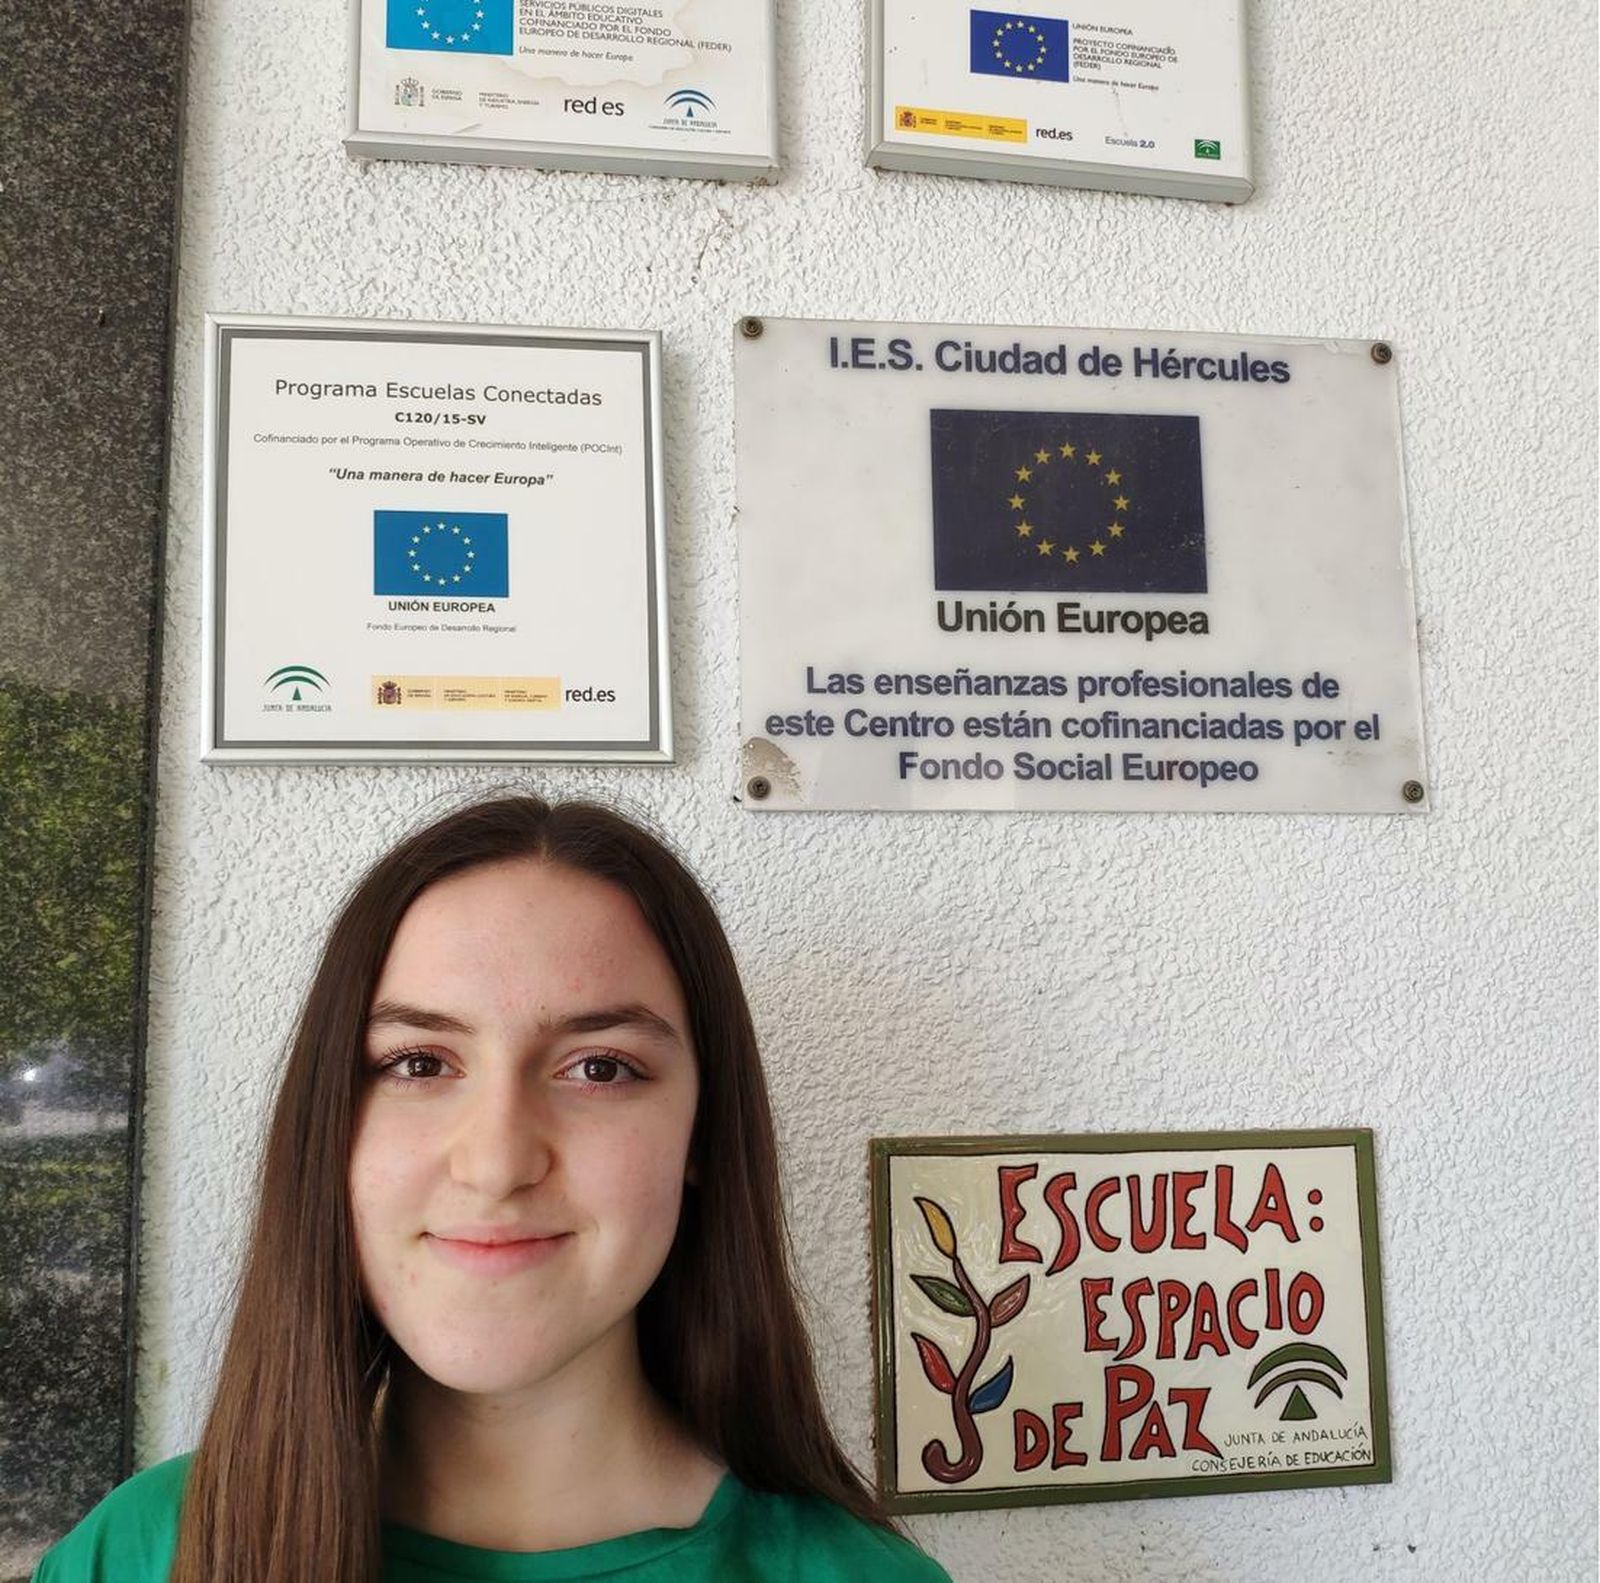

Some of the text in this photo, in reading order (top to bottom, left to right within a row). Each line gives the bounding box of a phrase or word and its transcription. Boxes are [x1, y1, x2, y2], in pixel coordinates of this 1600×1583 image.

[519, 8, 533, 17] EN
[535, 10, 547, 18] EL
[587, 14, 644, 25] EDUCATIVO
[616, 7, 664, 18] DIGITALES
[519, 18, 672, 37] COFINANCIADO POR EL FONDO
[519, 27, 733, 53] EUROPEO DE DESARROLLO REGIONAL (FEDER)
[570, 48, 580, 57] de
[1036, 127, 1074, 142] red.es
[1104, 136, 1156, 150] Escuela 2.0
[829, 336, 1292, 384] I.E.S. Ciudad de Hércules
[275, 379, 603, 406] Programa Escuelas Conectadas
[394, 410, 487, 426] C120/15-SV
[253, 432, 319, 445] Cofinanciado
[321, 436, 339, 446] por
[340, 435, 350, 445] el
[352, 435, 401, 448] Programa
[402, 436, 452, 449] Operativo
[453, 438, 466, 448] de
[468, 438, 527, 450] Crecimiento
[529, 440, 579, 454] Inteligente
[369, 470, 424, 482] manera
[427, 470, 446, 483] de
[450, 471, 491, 484] hacer
[388, 599, 497, 613] UNIÓN EUROPEA
[366, 622, 517, 635] Fondo Europeo de Desarrollo Regional
[936, 600, 1210, 642] Unión Europea
[565, 686, 616, 703] red.es
[806, 666, 1340, 704] Las enseñanzas profesionales de
[764, 708, 1381, 748] este Centro están cofinanciadas por el
[898, 751, 1260, 789] Fondo Social Europeo
[998, 1161, 1326, 1276] ESCUELA:
[1080, 1267, 1326, 1362] ESPACIO
[1012, 1363, 1225, 1473] DE PAZ
[1223, 1421, 1369, 1449] JUNTA DE ANDALUCÍA
[1191, 1442, 1372, 1474] CONSEJERÍA DE EDUCACIÓN
